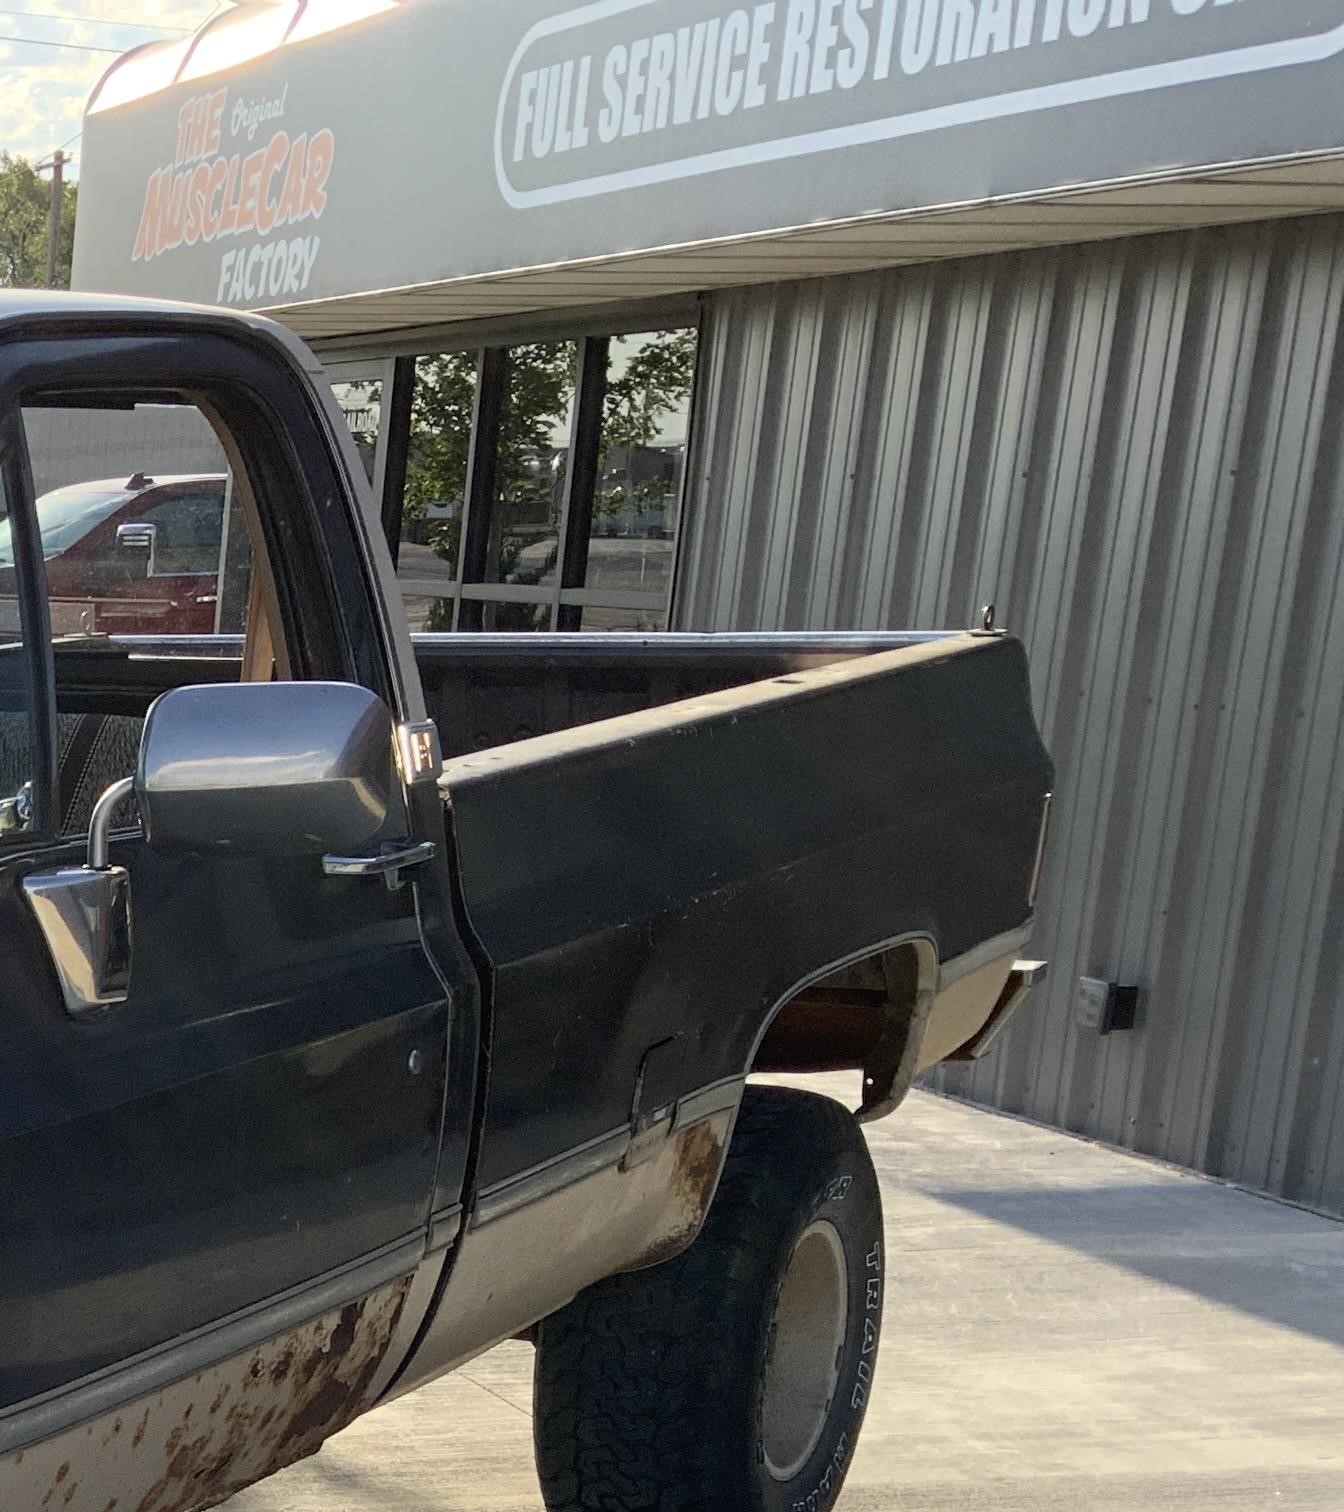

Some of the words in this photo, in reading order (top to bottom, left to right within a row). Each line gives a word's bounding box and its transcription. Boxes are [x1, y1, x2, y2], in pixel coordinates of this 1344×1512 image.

[175, 87, 228, 168] THE
[231, 82, 289, 140] Original
[512, 55, 592, 162] FULL
[598, 2, 777, 144] SERVICE
[777, 0, 1149, 101] RESTORA
[131, 128, 335, 262] MUSCLECAR
[217, 236, 321, 303] FACTORY
[851, 1241, 881, 1409] TRAIL
